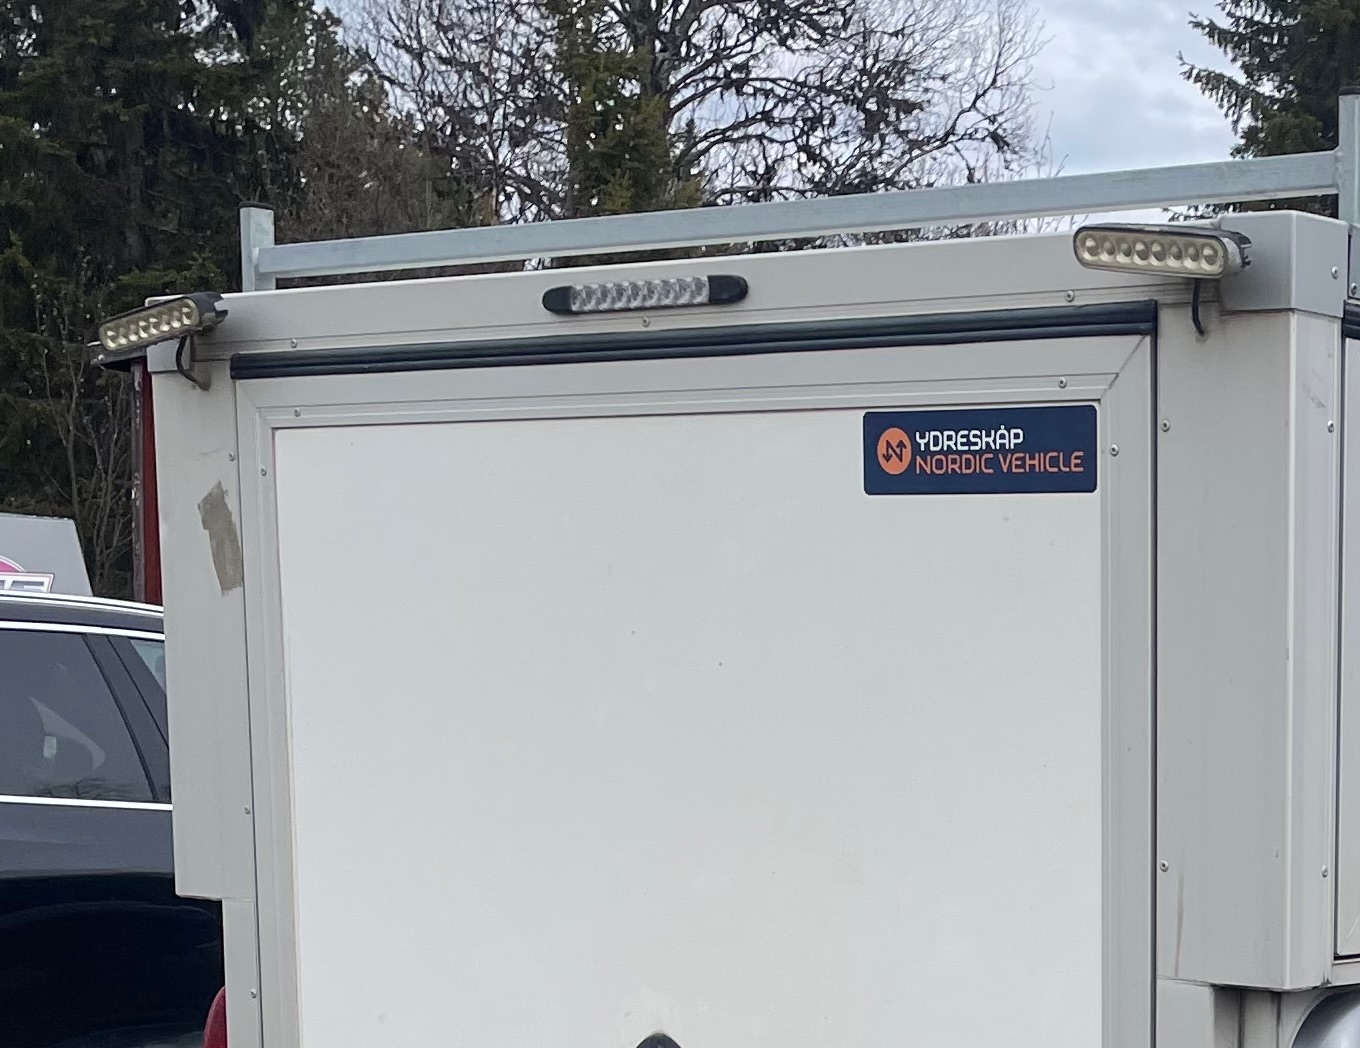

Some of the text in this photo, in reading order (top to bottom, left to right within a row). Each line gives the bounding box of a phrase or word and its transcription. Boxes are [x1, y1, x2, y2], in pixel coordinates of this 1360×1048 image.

[915, 425, 1024, 451] YDRESKÅP
[915, 451, 1085, 475] NORDIC VEHICLE
